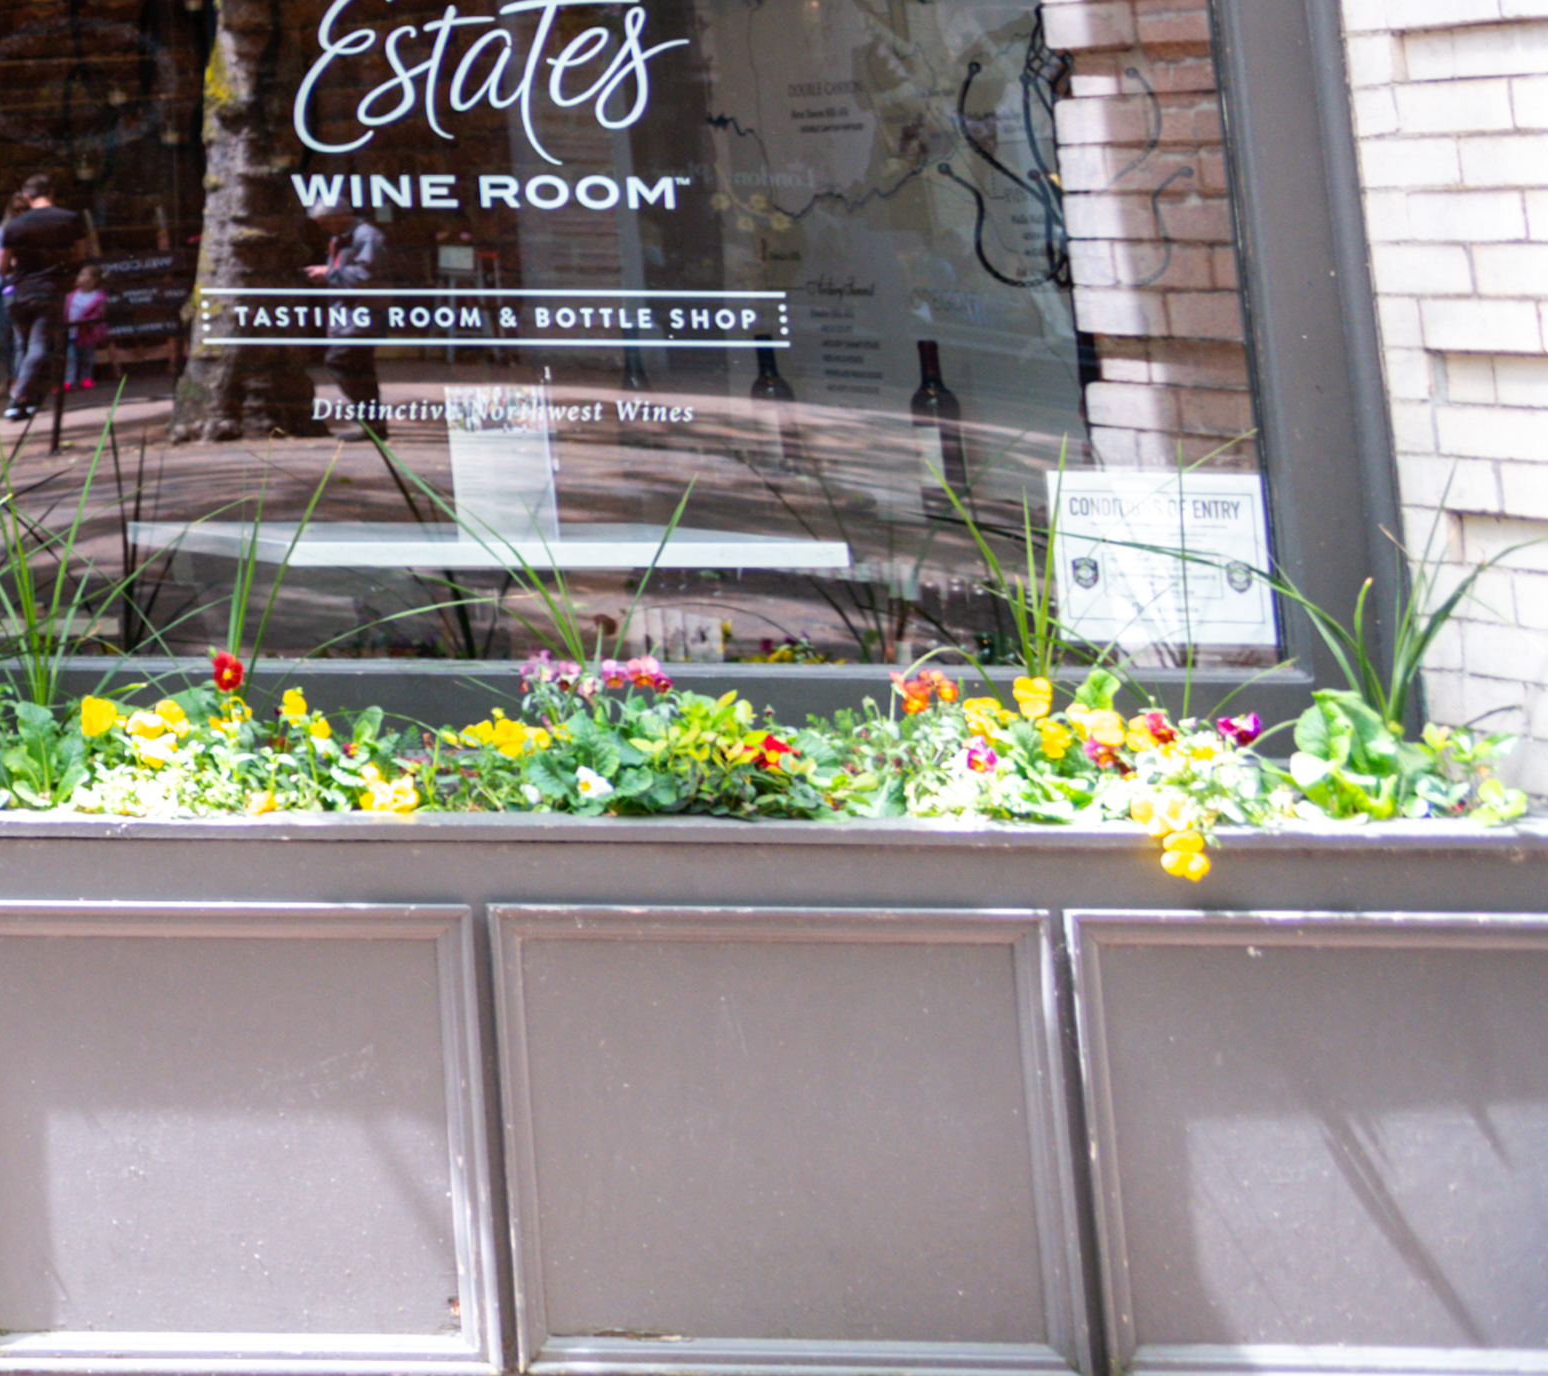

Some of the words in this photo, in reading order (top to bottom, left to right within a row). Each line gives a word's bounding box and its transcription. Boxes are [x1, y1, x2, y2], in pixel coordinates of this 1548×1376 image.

[291, 174, 460, 208] WINE
[234, 305, 372, 329] TASTING
[388, 306, 483, 329] ROOM
[499, 307, 517, 330] &
[535, 307, 654, 330] BOTTLE
[670, 308, 758, 331] SHOP
[615, 398, 695, 424] Wines
[1192, 500, 1241, 520] ENTRY
